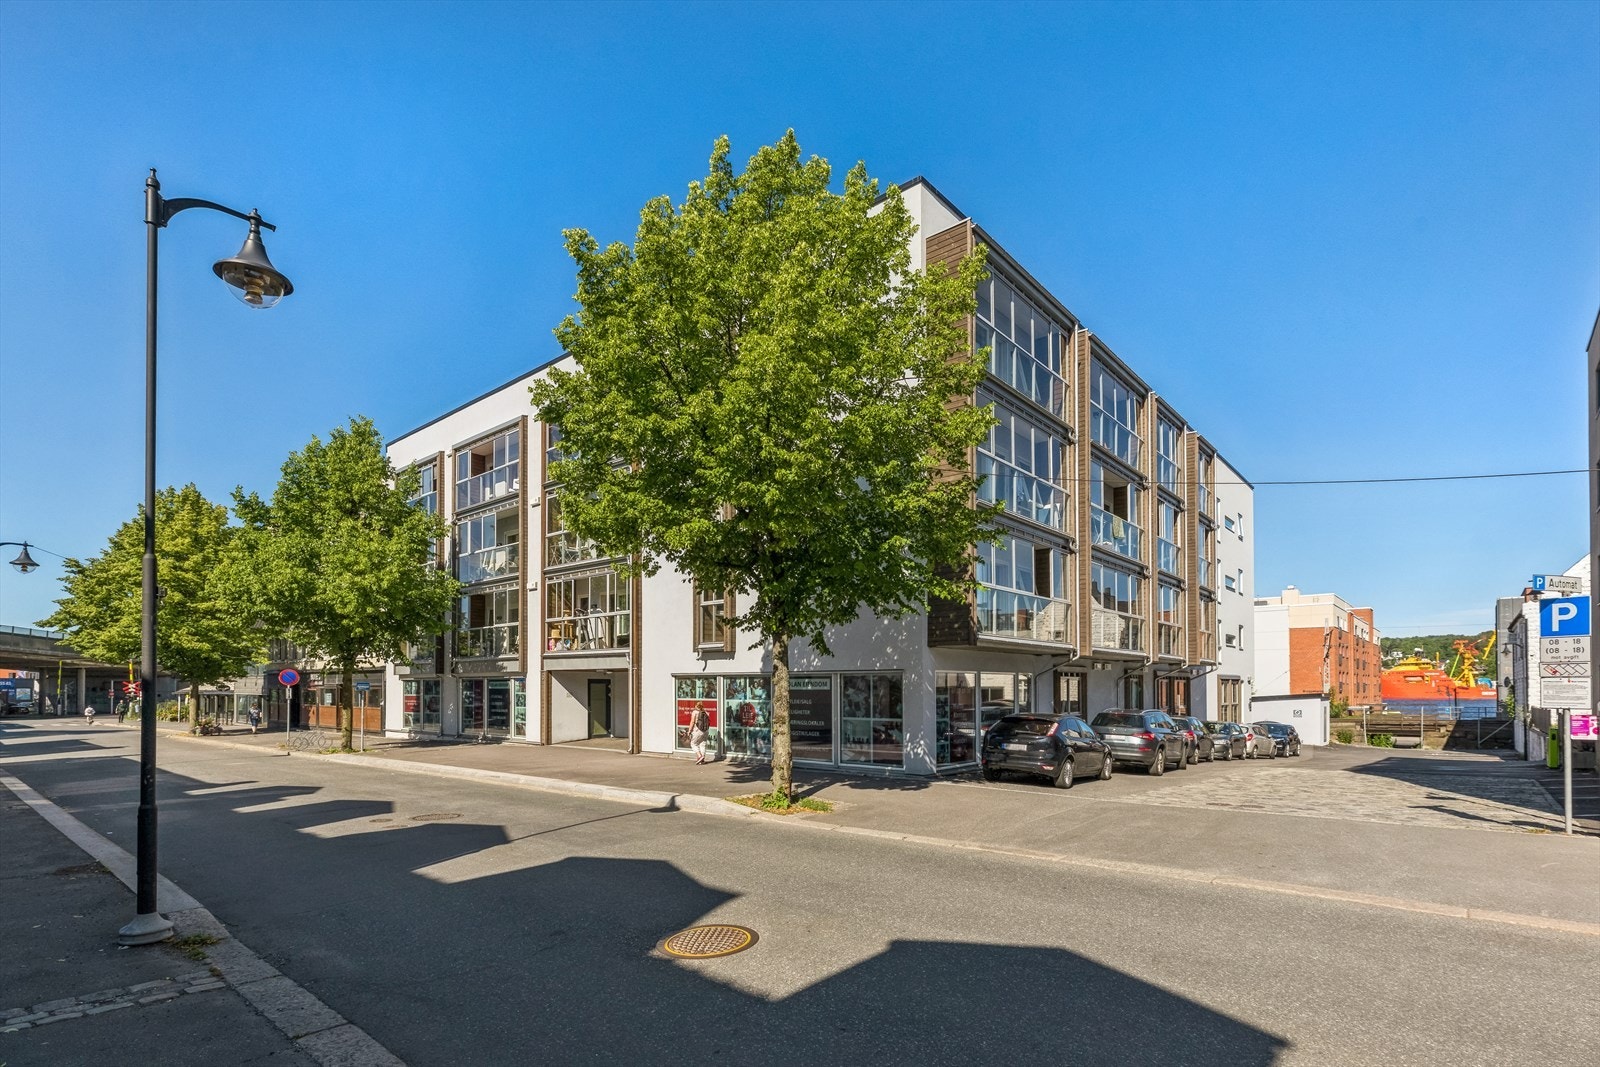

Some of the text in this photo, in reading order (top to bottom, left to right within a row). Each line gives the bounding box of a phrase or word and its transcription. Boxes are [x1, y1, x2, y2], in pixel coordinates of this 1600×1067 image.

[1536, 577, 1578, 590] P Automat
[1552, 602, 1578, 632] P
[1572, 637, 1581, 645] 18
[1545, 647, 1560, 655] (08
[1572, 646, 1585, 654] 18)
